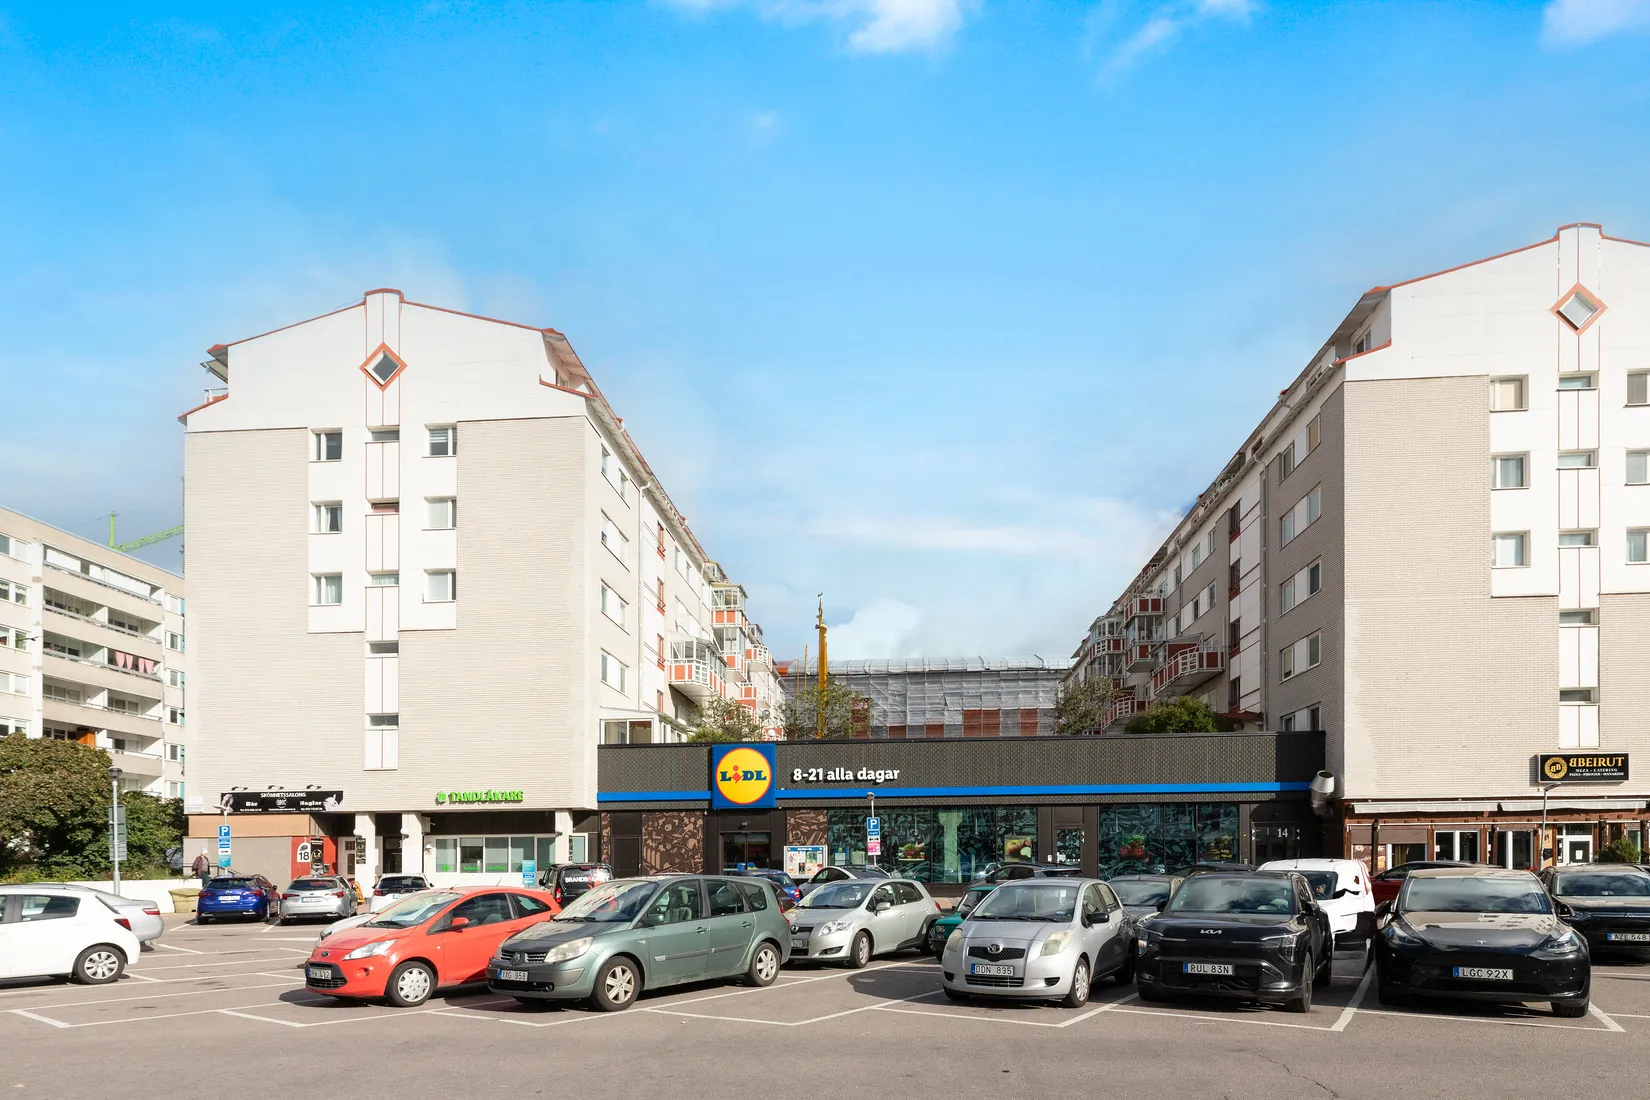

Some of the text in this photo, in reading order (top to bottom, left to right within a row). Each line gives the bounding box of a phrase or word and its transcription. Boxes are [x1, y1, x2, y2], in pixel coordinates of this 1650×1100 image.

[793, 767, 900, 783] 8-21 alla dagar
[870, 819, 878, 829] P
[221, 826, 229, 836] P
[1276, 828, 1289, 838] 14
[299, 851, 310, 861] 18
[1190, 964, 1229, 974] RUL 83N
[1462, 968, 1509, 979] LGC 92X
